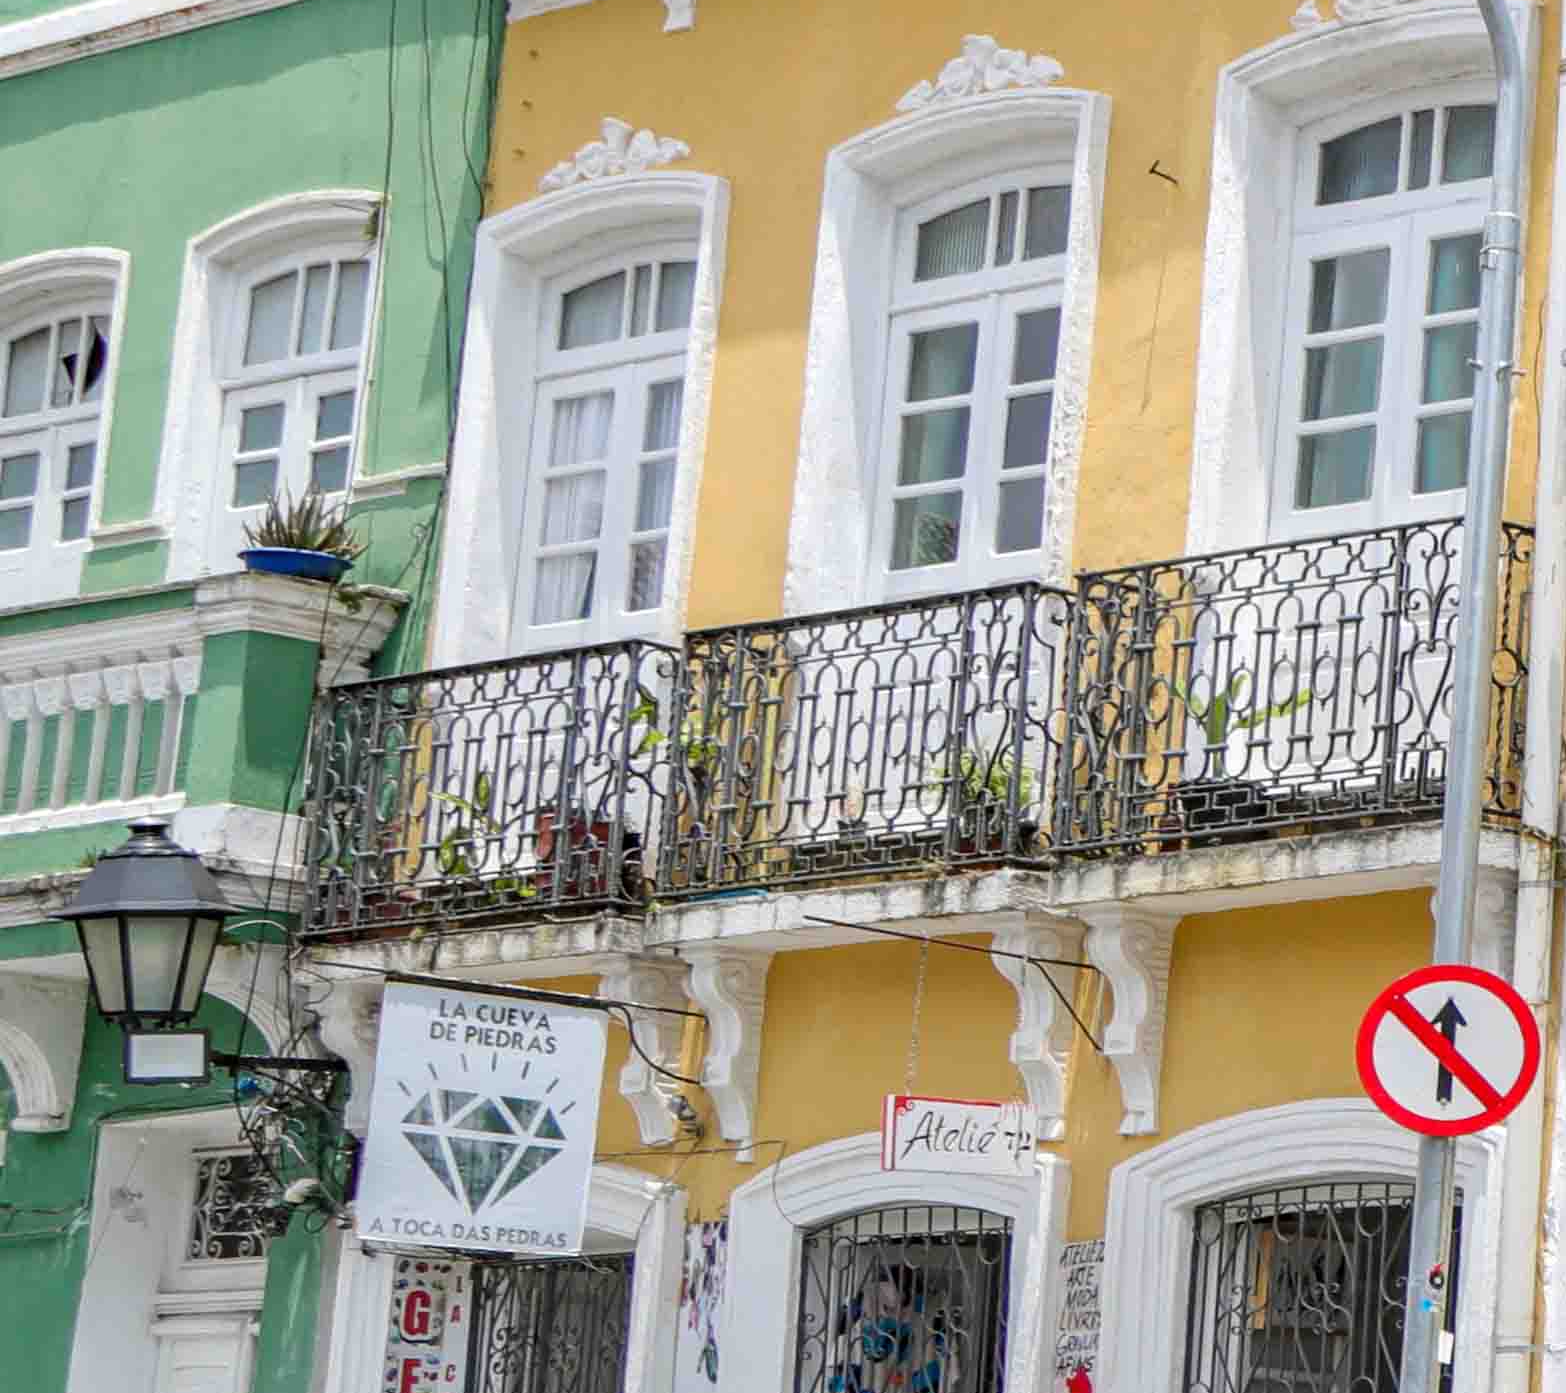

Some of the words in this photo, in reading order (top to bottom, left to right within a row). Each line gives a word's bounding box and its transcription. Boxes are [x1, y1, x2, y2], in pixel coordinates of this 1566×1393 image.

[439, 999, 467, 1018] LA
[476, 1005, 552, 1031] CUEVA
[430, 1022, 456, 1042] DE
[464, 1026, 558, 1055] PIEDRAS
[369, 1217, 385, 1234] A
[392, 1218, 443, 1238] TOCA
[450, 1223, 490, 1241] DAS
[496, 1227, 567, 1248] PEDRAS
